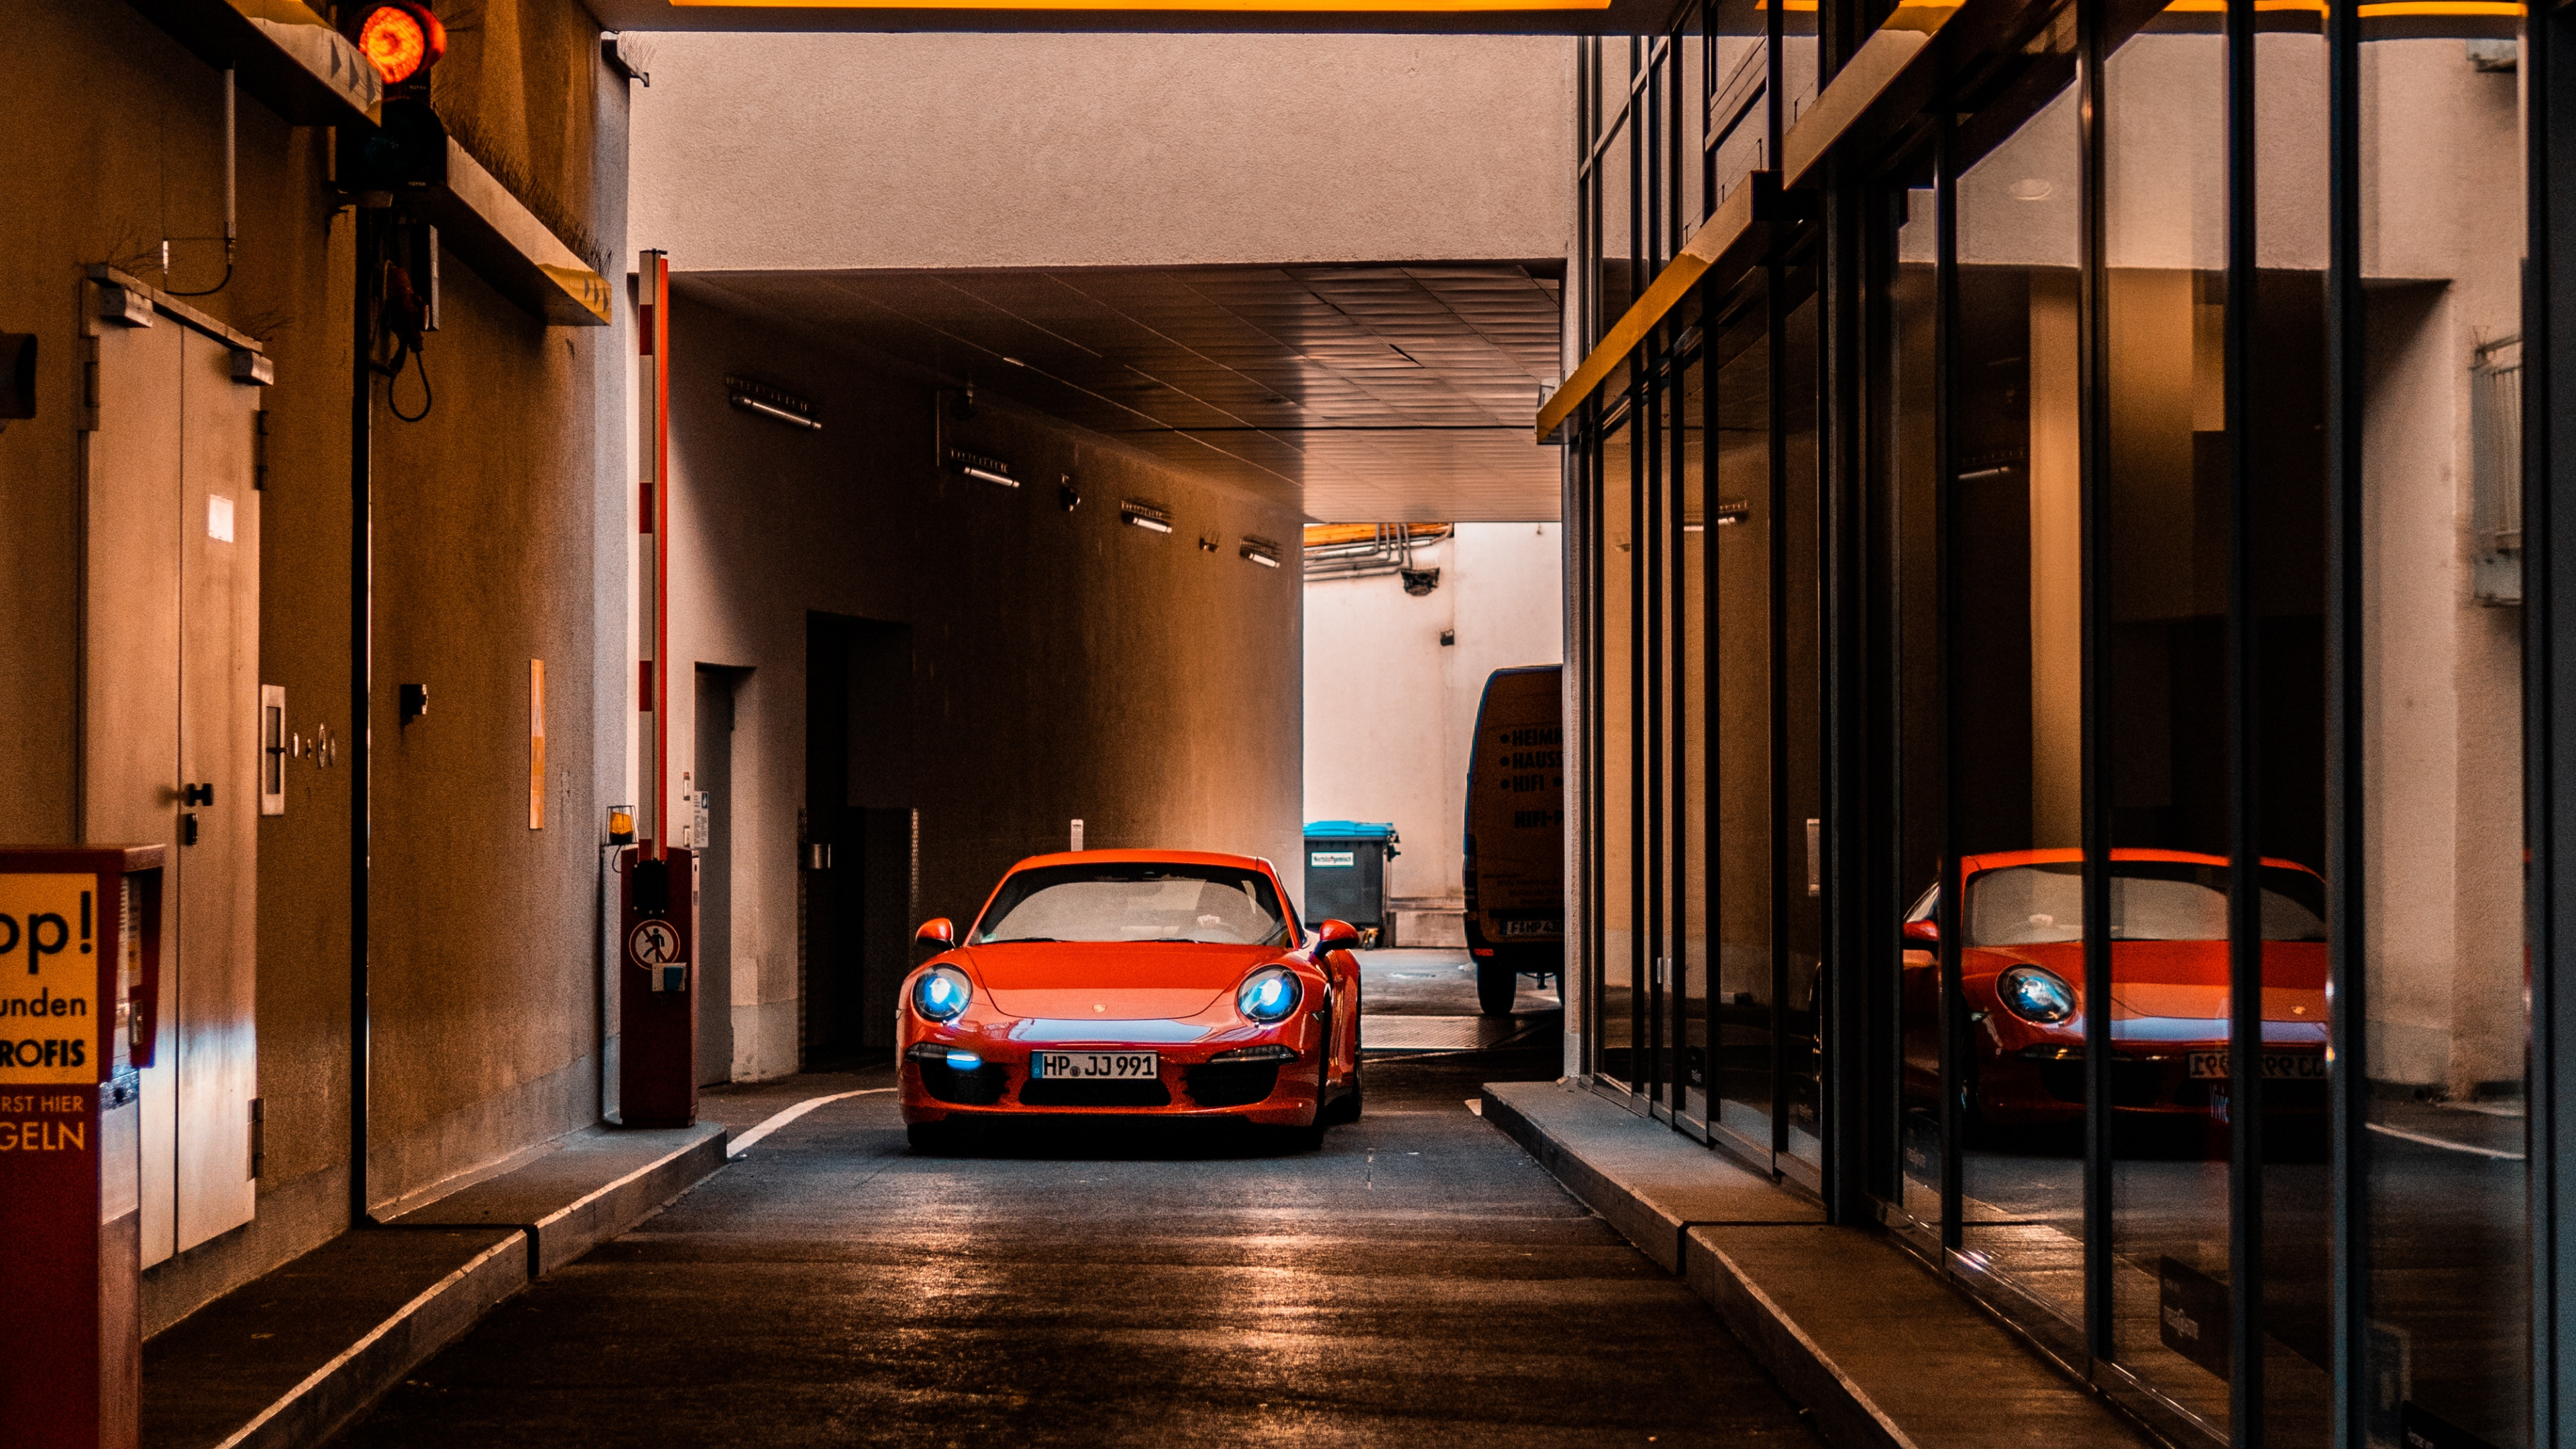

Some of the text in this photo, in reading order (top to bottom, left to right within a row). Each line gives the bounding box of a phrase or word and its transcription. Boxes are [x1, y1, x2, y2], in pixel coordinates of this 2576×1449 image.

[1513, 773, 1544, 792] HIFI
[1044, 1056, 1155, 1076] HP JJ 991
[41, 1095, 84, 1112] HIER
